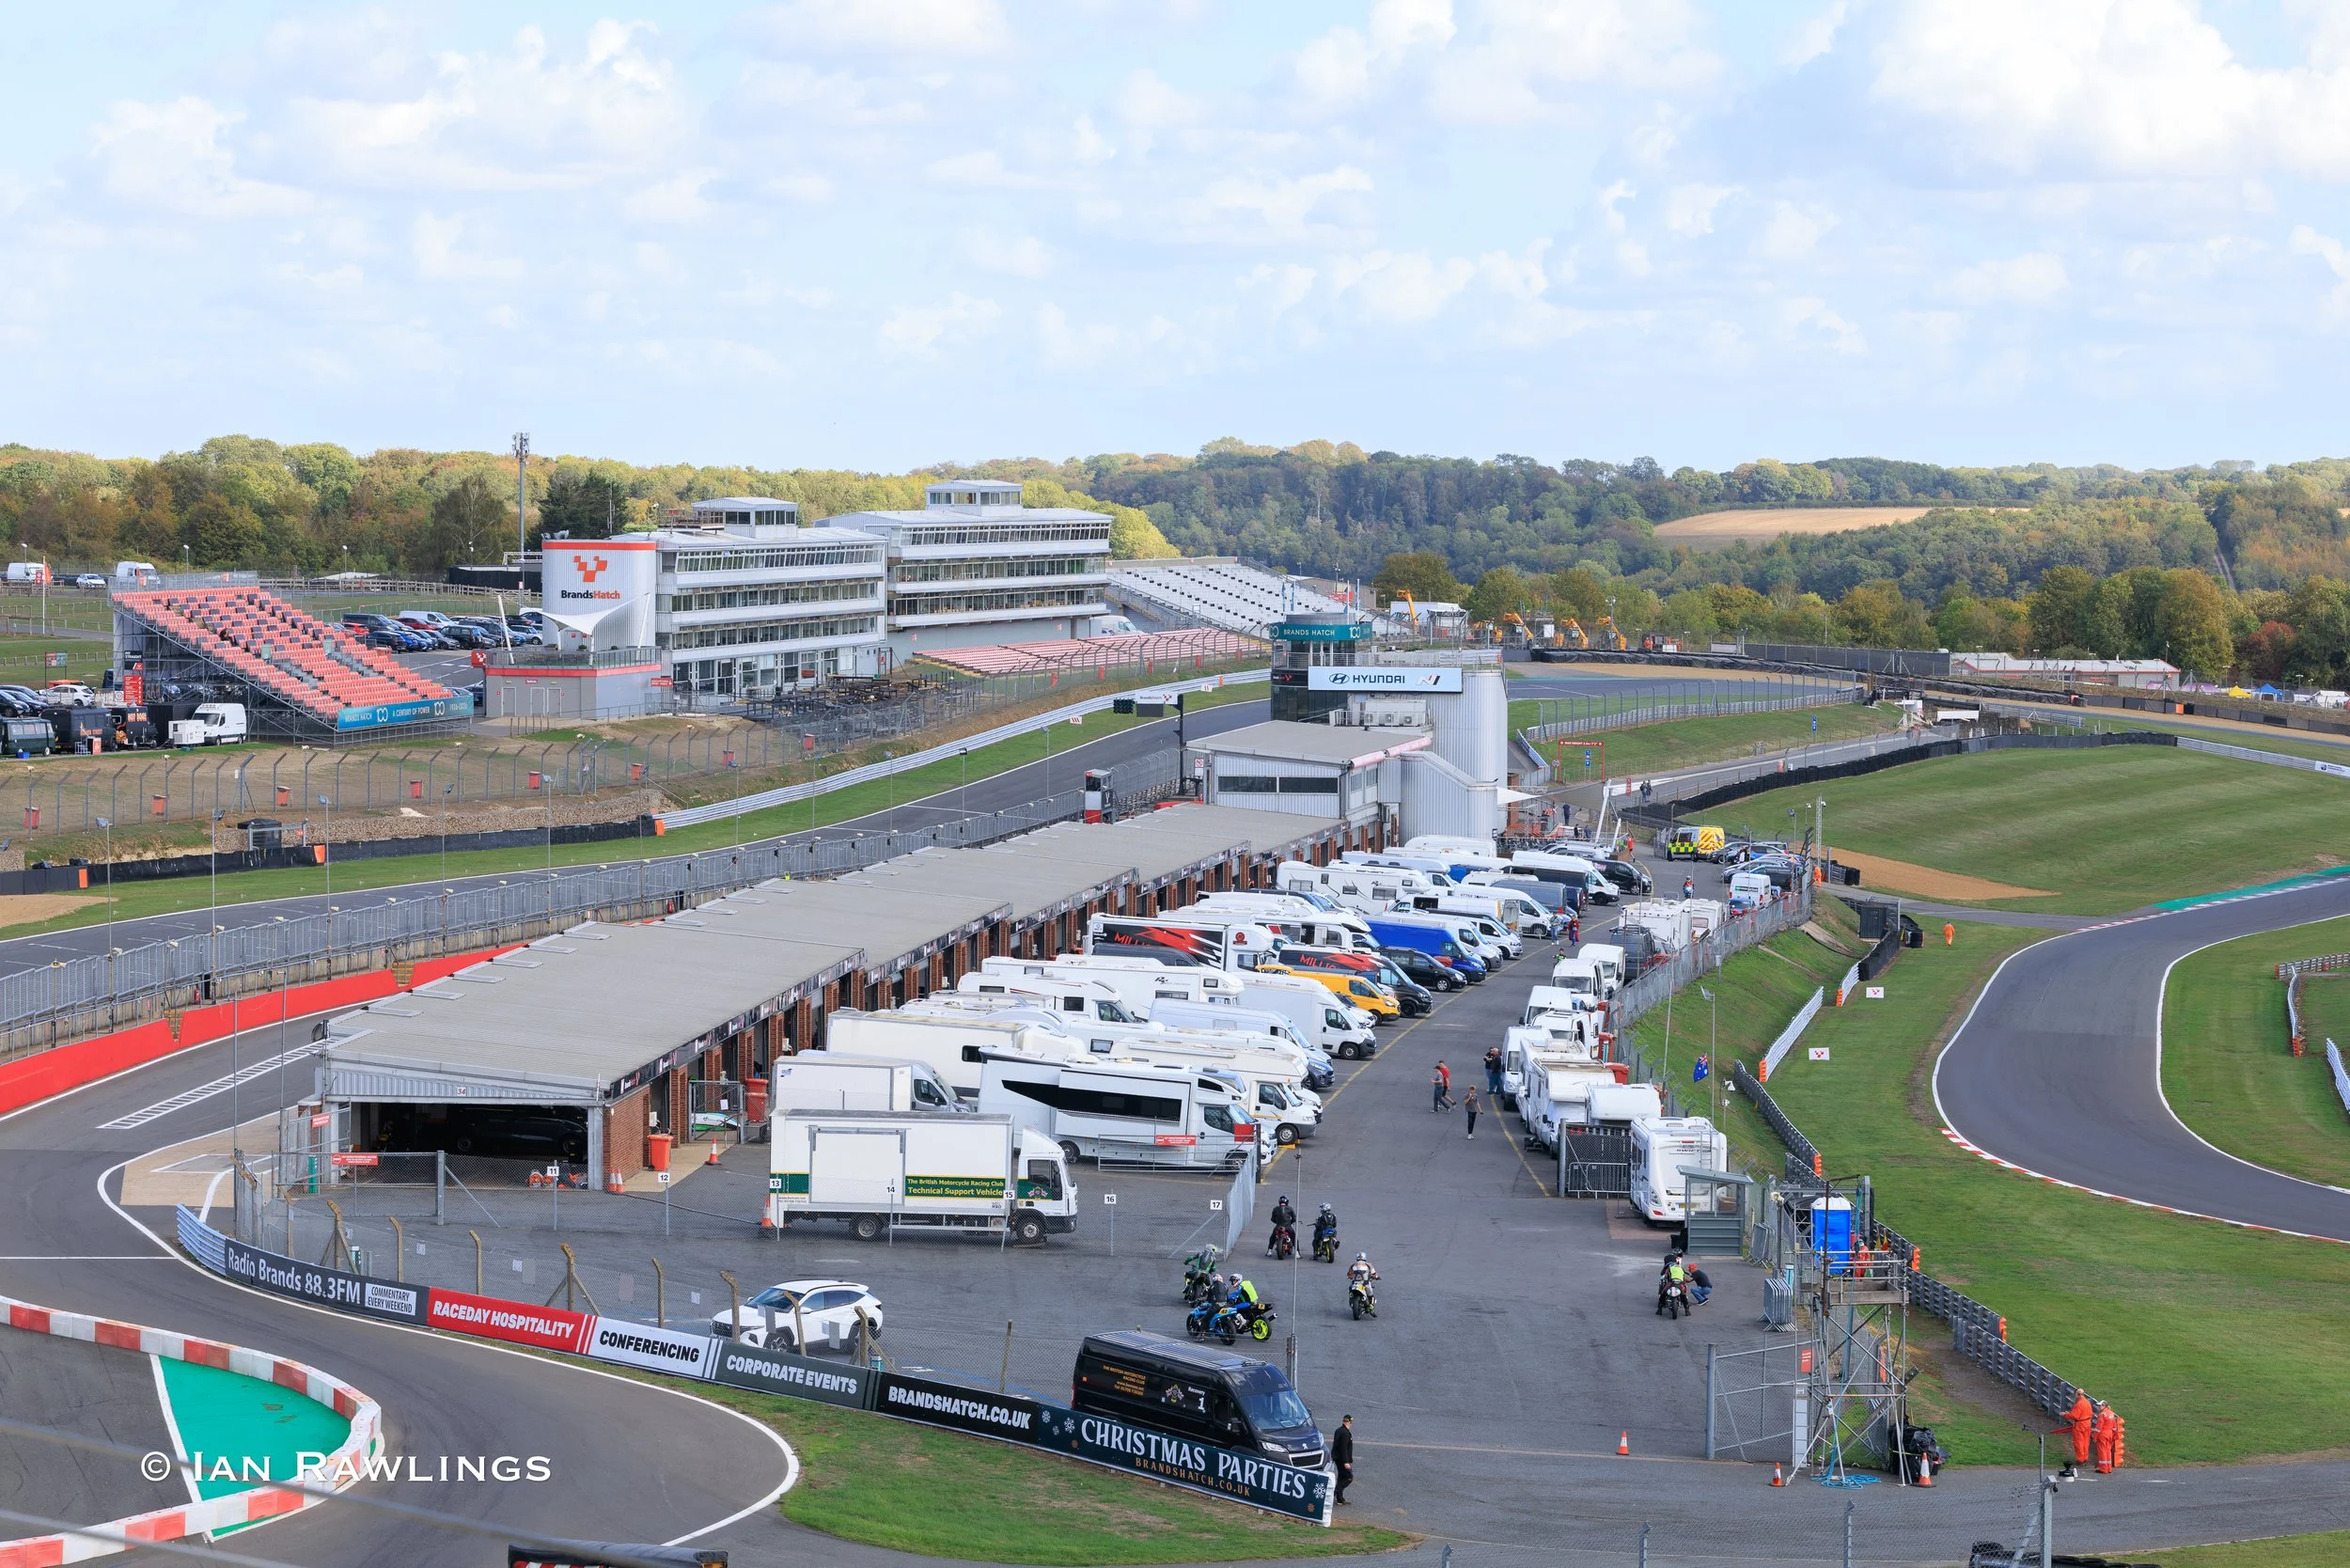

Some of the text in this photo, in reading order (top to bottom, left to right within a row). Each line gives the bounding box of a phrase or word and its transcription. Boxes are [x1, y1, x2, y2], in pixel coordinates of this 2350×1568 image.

[561, 590, 620, 599] BrandsHatch
[1353, 674, 1405, 683] HYUNDAI
[345, 713, 360, 722] BRANDS
[360, 712, 372, 721] HATCH
[396, 708, 411, 717] CENTURY
[457, 1087, 466, 1096] 34
[944, 1188, 974, 1196] Support
[228, 1247, 360, 1304] Radio Brands 88.3FM
[371, 1286, 410, 1301] COMMENTARY
[368, 1296, 412, 1313] EVERY WEEKEND
[433, 1301, 575, 1338] RACEDAY HOSPITALITY
[600, 1330, 700, 1363] CONFERENCING
[727, 1355, 857, 1394] CORPORATE EVENTS
[1188, 1386, 1205, 1395] Recovery
[888, 1386, 1031, 1429] BRANDSHATCH.CO.UK
[1198, 1397, 1204, 1410] 1
[1081, 1418, 1306, 1499] CHRISTMAS PARTIES
[1136, 1458, 1250, 1497] BRANDSHATCH.CO.UK
